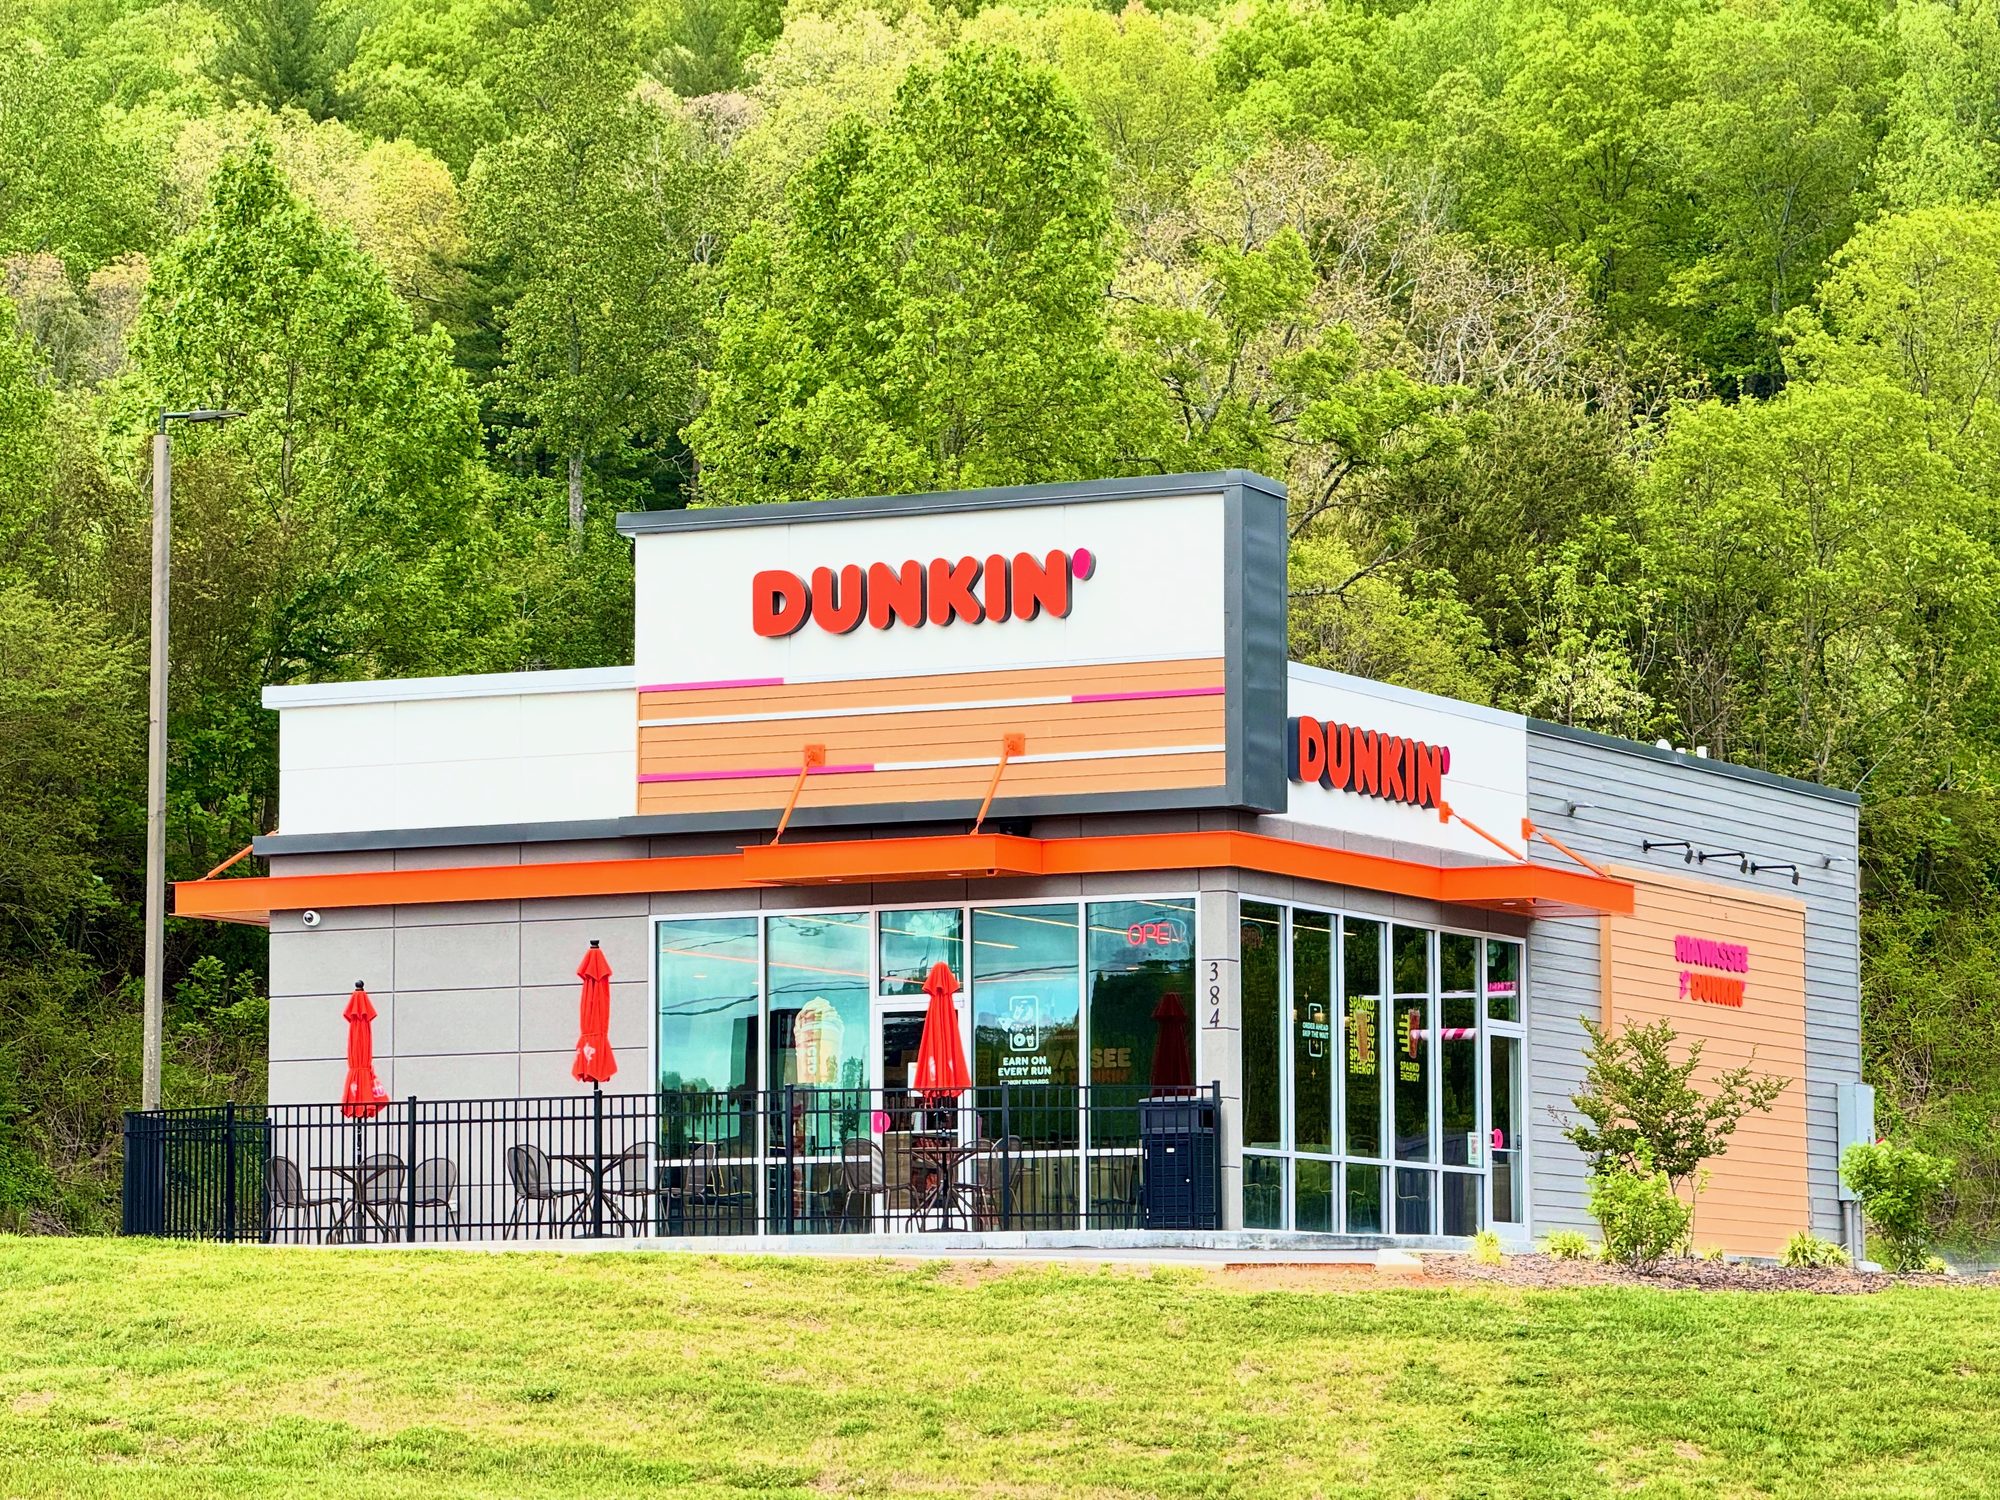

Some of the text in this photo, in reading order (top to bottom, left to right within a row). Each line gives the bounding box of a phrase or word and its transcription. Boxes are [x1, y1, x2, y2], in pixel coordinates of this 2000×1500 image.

[752, 547, 1096, 638] DUNKIN'
[1296, 715, 1451, 809] DUNKIN'
[1126, 921, 1184, 947] OPEN
[998, 1066, 1052, 1076] EVERY RUN
[1003, 1056, 1047, 1066] EARN ON
